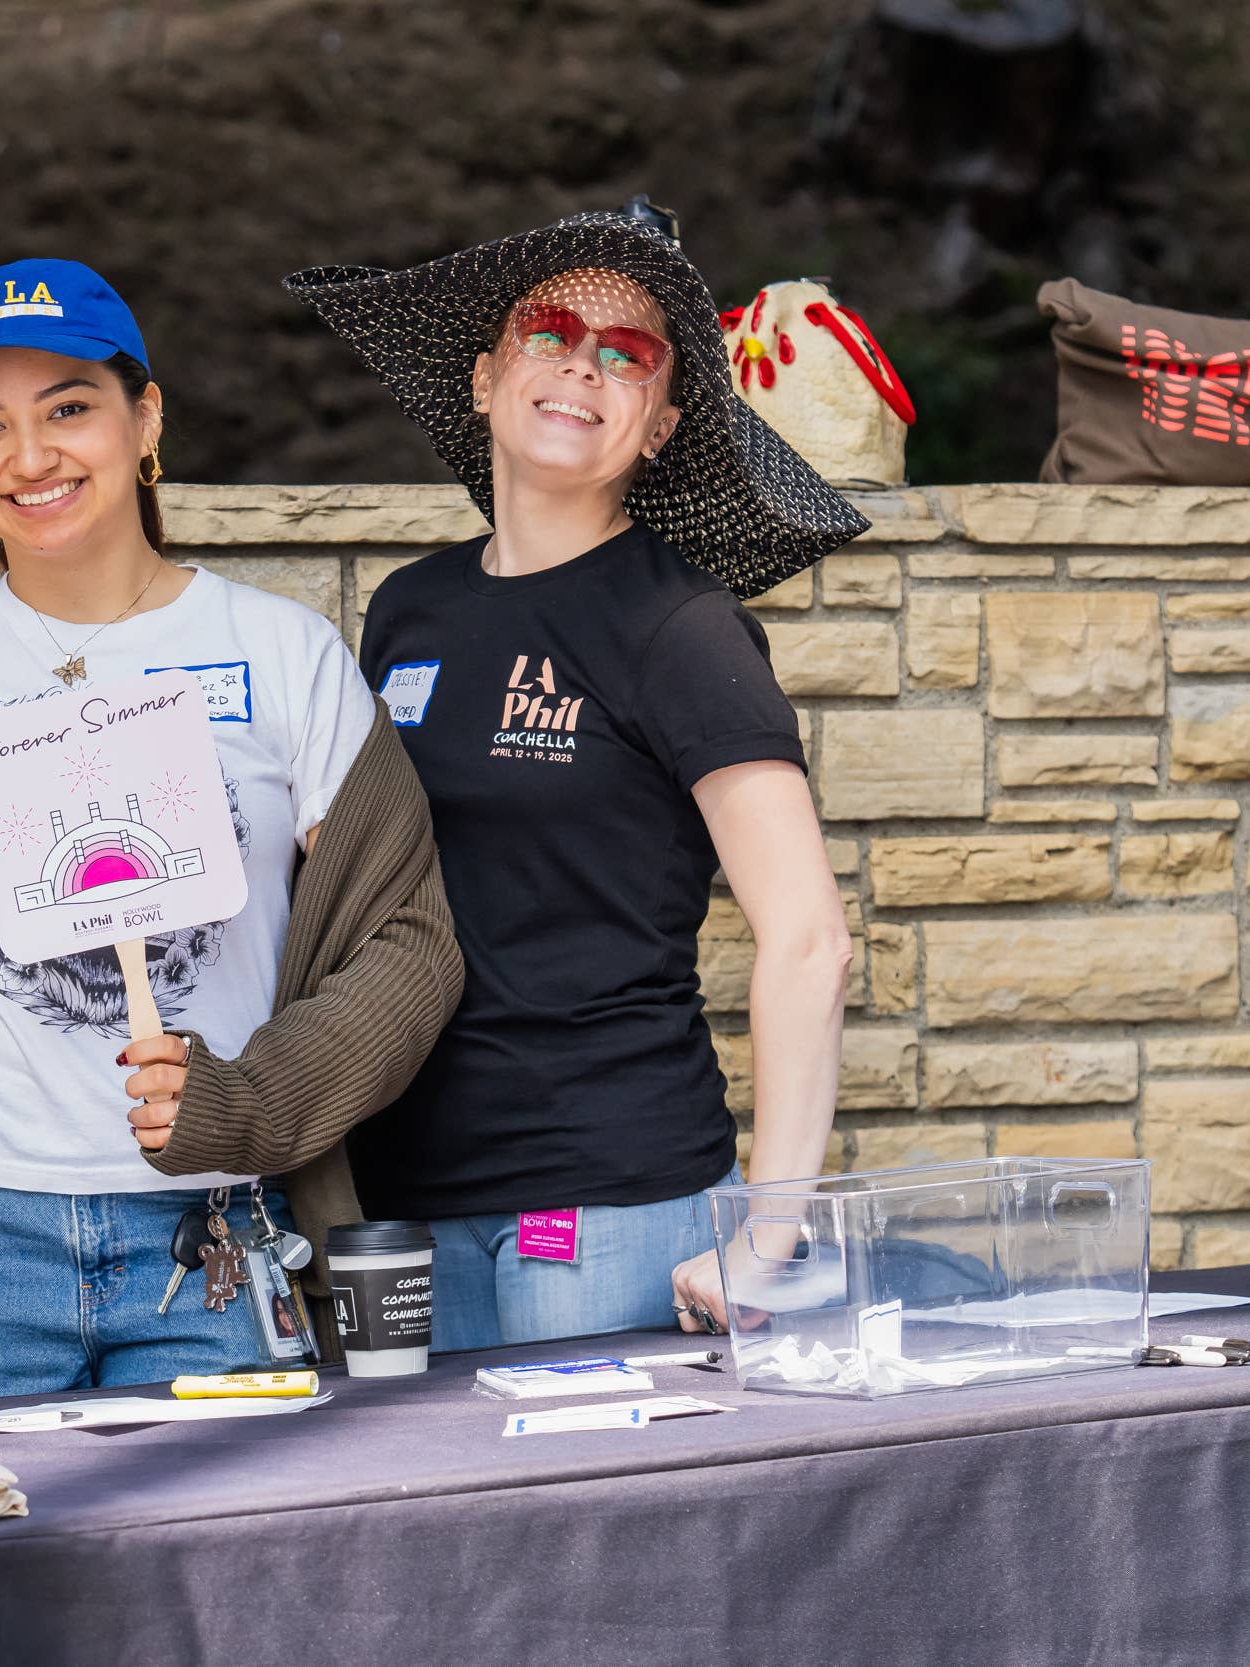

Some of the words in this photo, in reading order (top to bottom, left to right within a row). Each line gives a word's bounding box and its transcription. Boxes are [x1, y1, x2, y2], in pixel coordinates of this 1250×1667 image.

[508, 655, 556, 694] LA
[207, 695, 229, 705] RD
[80, 690, 186, 734] Summer
[501, 692, 584, 731] Phil
[493, 732, 576, 750] COACHELLA
[489, 748, 512, 757] APRIL
[515, 749, 524, 758] 12
[549, 752, 573, 763] 2025
[122, 903, 161, 915] HOLLYWOOD
[73, 920, 88, 932] LA
[89, 914, 113, 928] Phil
[124, 910, 164, 928] BOWL
[551, 1218, 573, 1229] FORD
[396, 1276, 431, 1289] COFFEE
[381, 1291, 433, 1305] COMMUNIT
